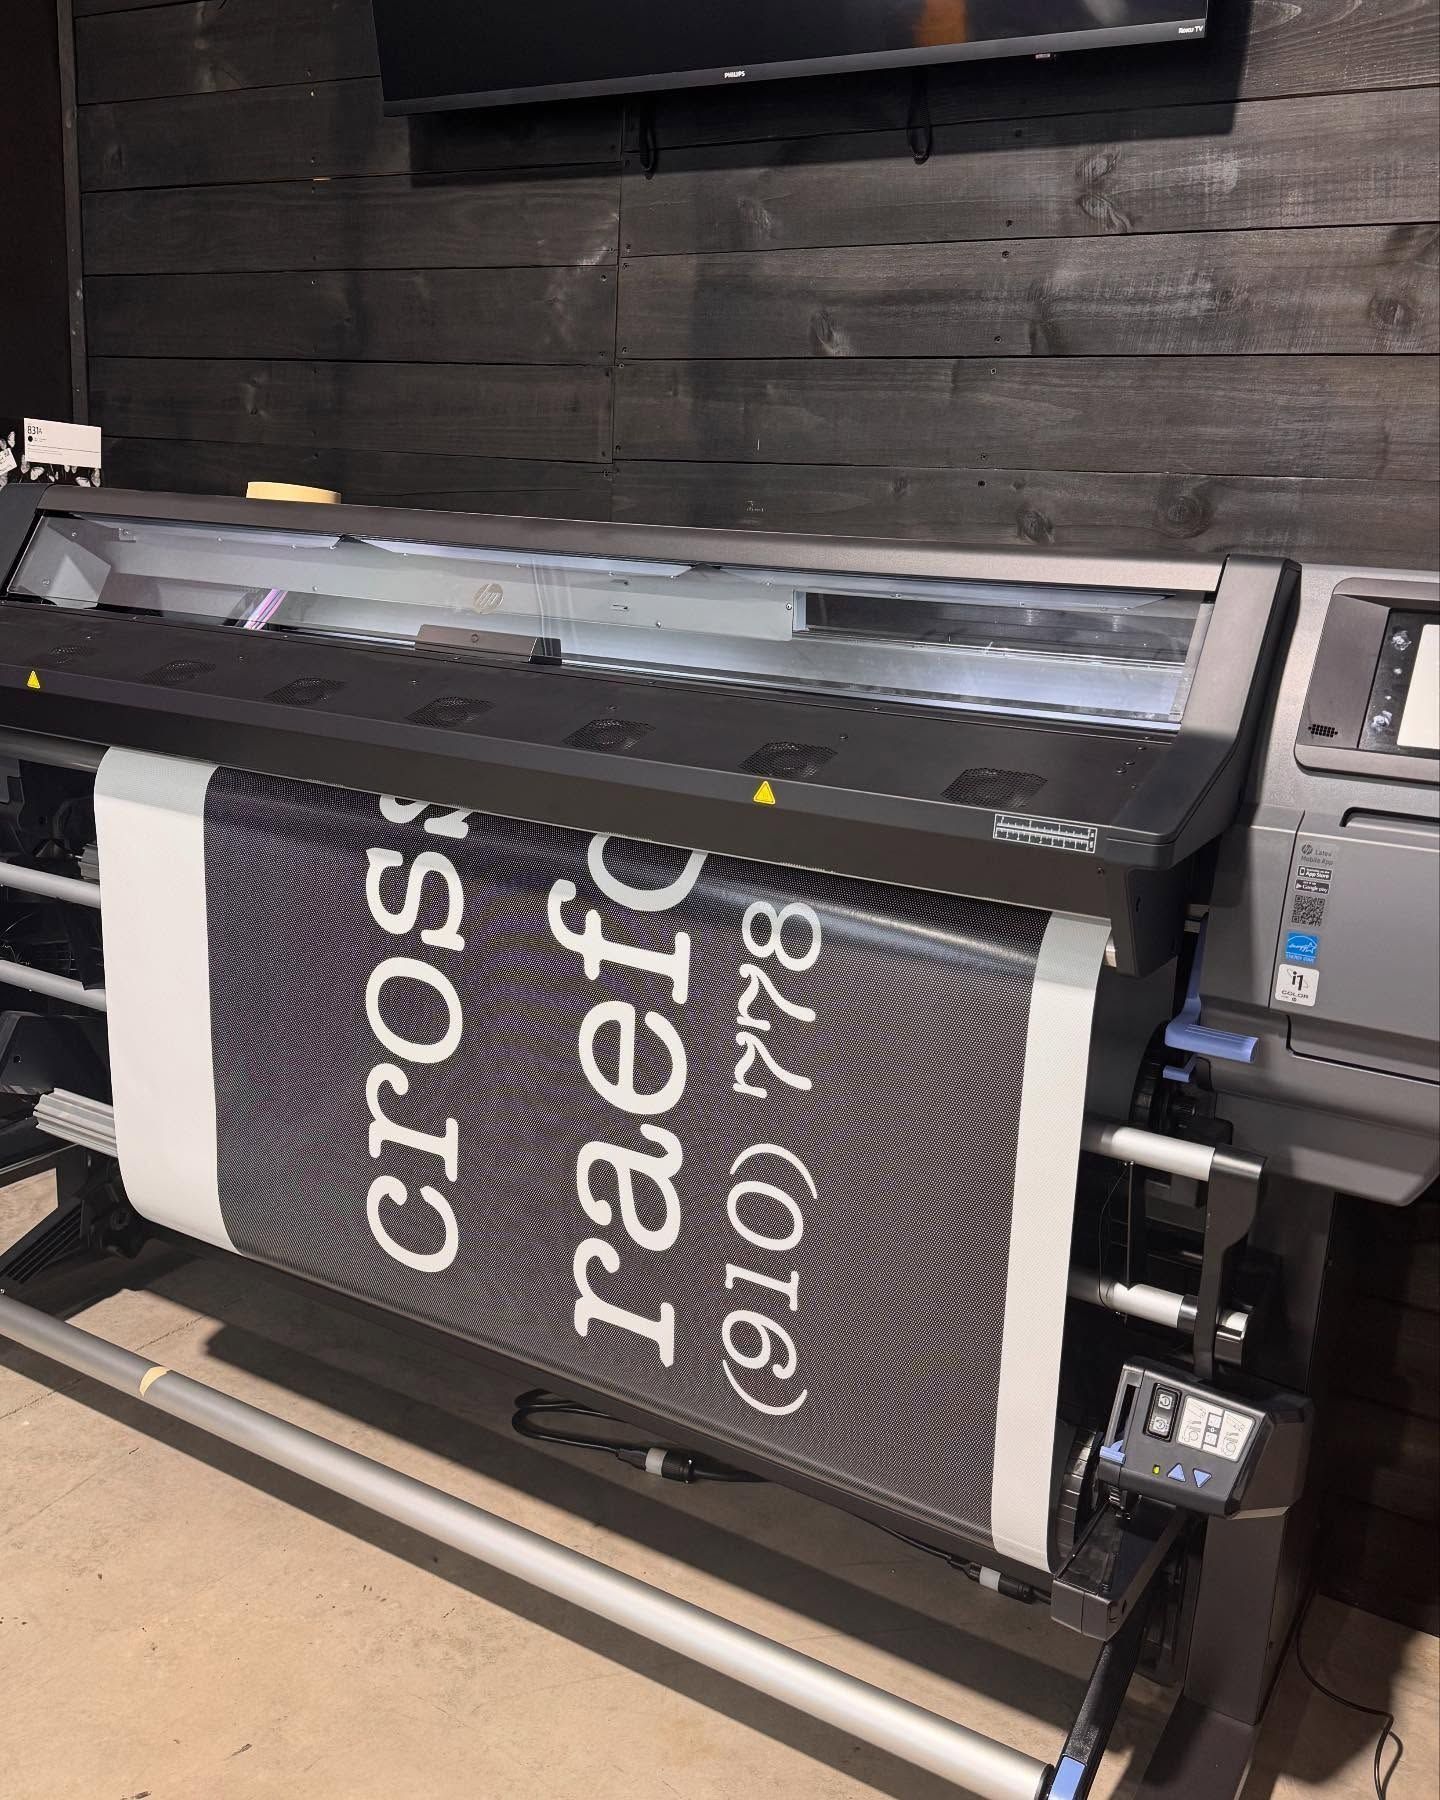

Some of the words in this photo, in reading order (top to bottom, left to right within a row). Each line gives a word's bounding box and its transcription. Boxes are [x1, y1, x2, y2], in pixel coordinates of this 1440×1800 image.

[724, 70, 746, 79] PHILIPS
[731, 899, 823, 1100] 778
[722, 1143, 819, 1416] (910)
